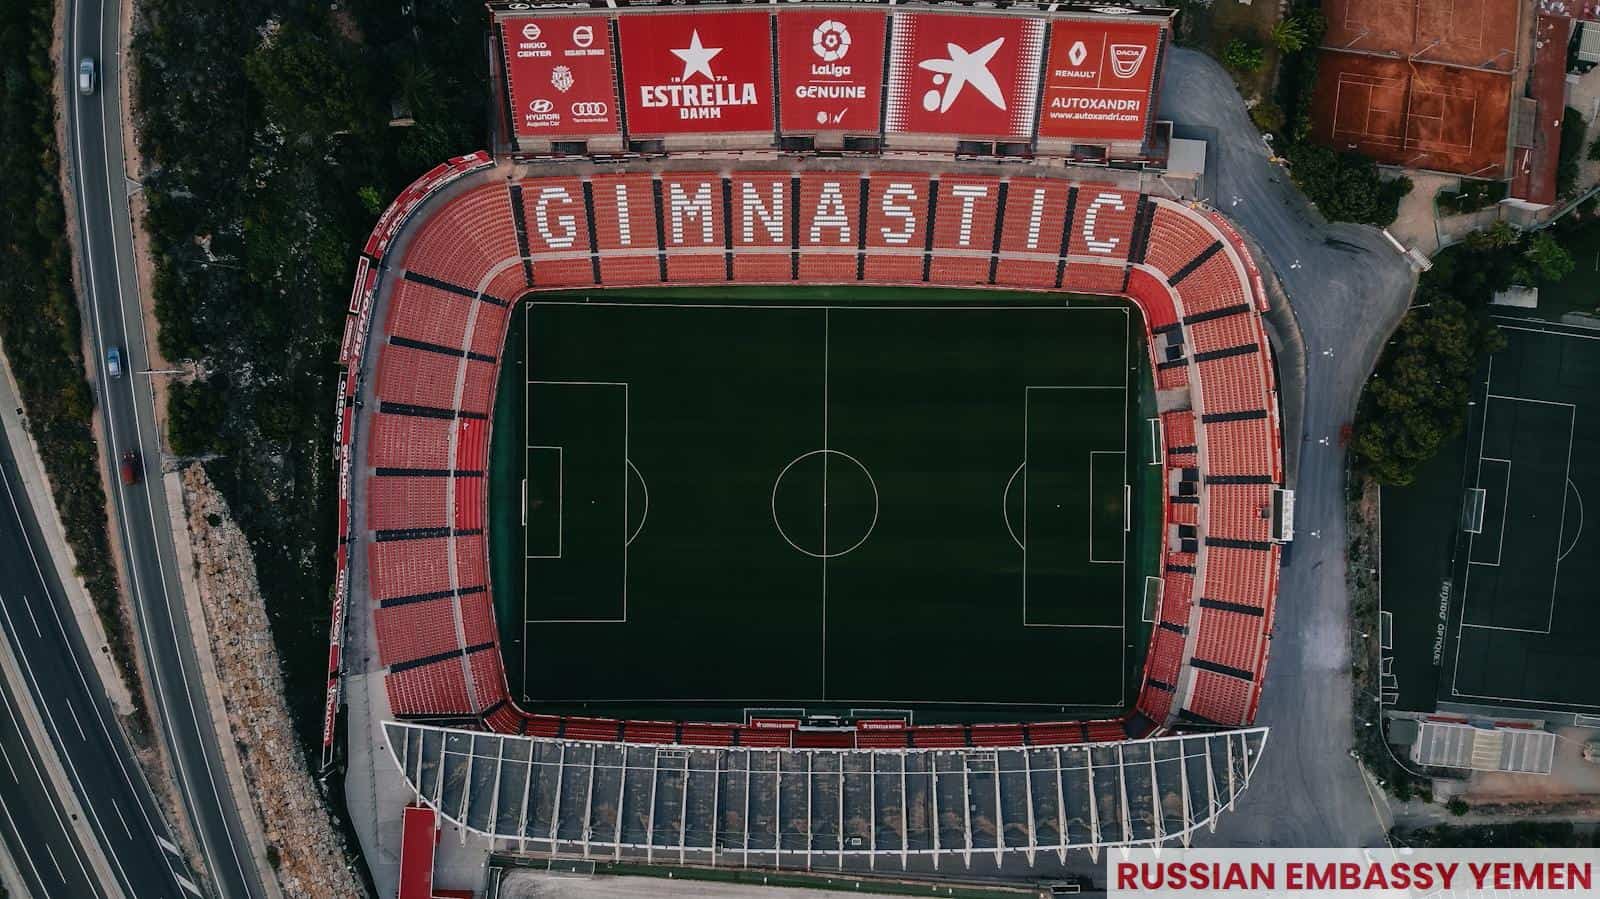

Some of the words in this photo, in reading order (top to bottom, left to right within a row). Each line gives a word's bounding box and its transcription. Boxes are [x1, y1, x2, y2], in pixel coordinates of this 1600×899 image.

[517, 50, 552, 58] CENTER
[812, 63, 851, 77] LaLiga
[1055, 69, 1096, 78] RENAULT
[641, 83, 758, 107] ESTRELLA
[796, 85, 866, 98] GENUINE
[1051, 97, 1140, 111] AUTOXANDRI
[526, 113, 560, 121] HYUNDAI
[680, 107, 721, 119] DAMM
[1050, 111, 1139, 122] www.autoxandri.com
[354, 289, 370, 356] REPSOL
